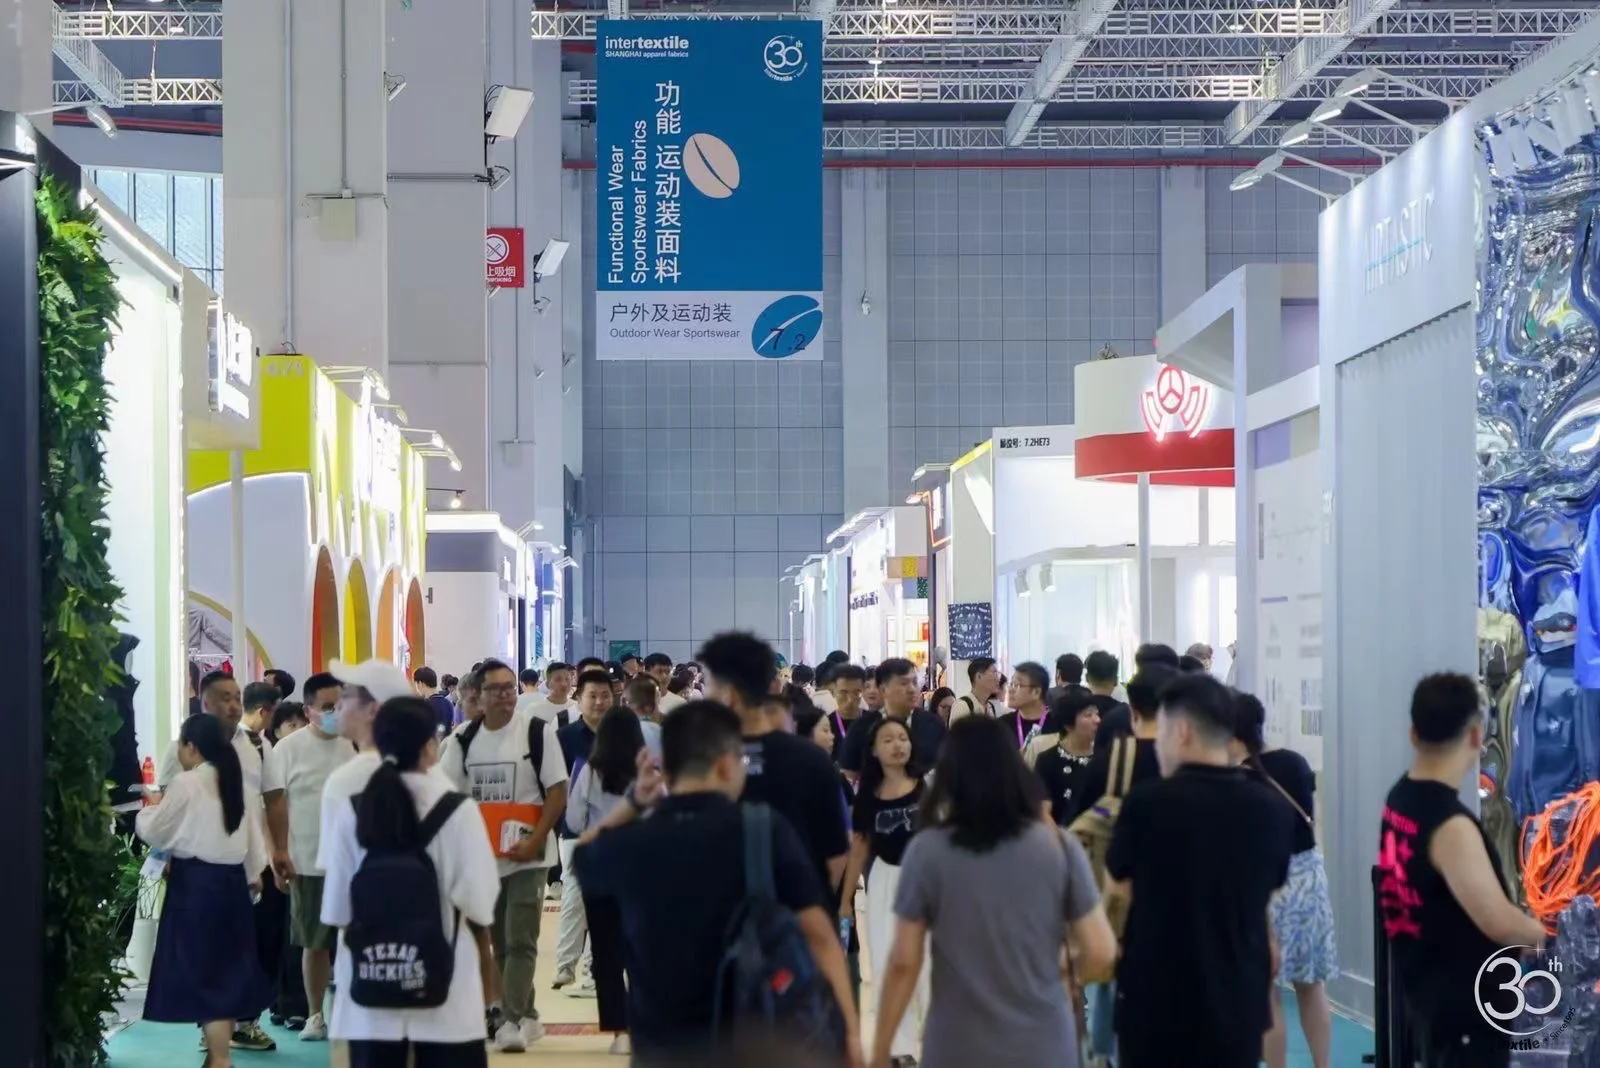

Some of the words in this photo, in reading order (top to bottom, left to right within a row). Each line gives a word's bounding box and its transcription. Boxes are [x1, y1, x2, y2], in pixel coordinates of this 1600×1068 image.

[605, 35, 689, 49] intertextile
[643, 51, 667, 59] apparel
[654, 80, 681, 135] 功能
[631, 120, 647, 182] Fabrics
[608, 145, 624, 191] Wear
[654, 145, 681, 284] 运动装面料
[608, 197, 624, 284] Functional
[631, 187, 650, 284] Sportswear
[610, 303, 732, 323] 户外及运动装
[609, 328, 650, 338] Outdoor
[653, 328, 680, 338] Wear
[683, 327, 741, 340] Sportswear
[769, 328, 806, 350] 7.2
[362, 943, 419, 962] TEXAS
[359, 960, 426, 981] DICKIES
